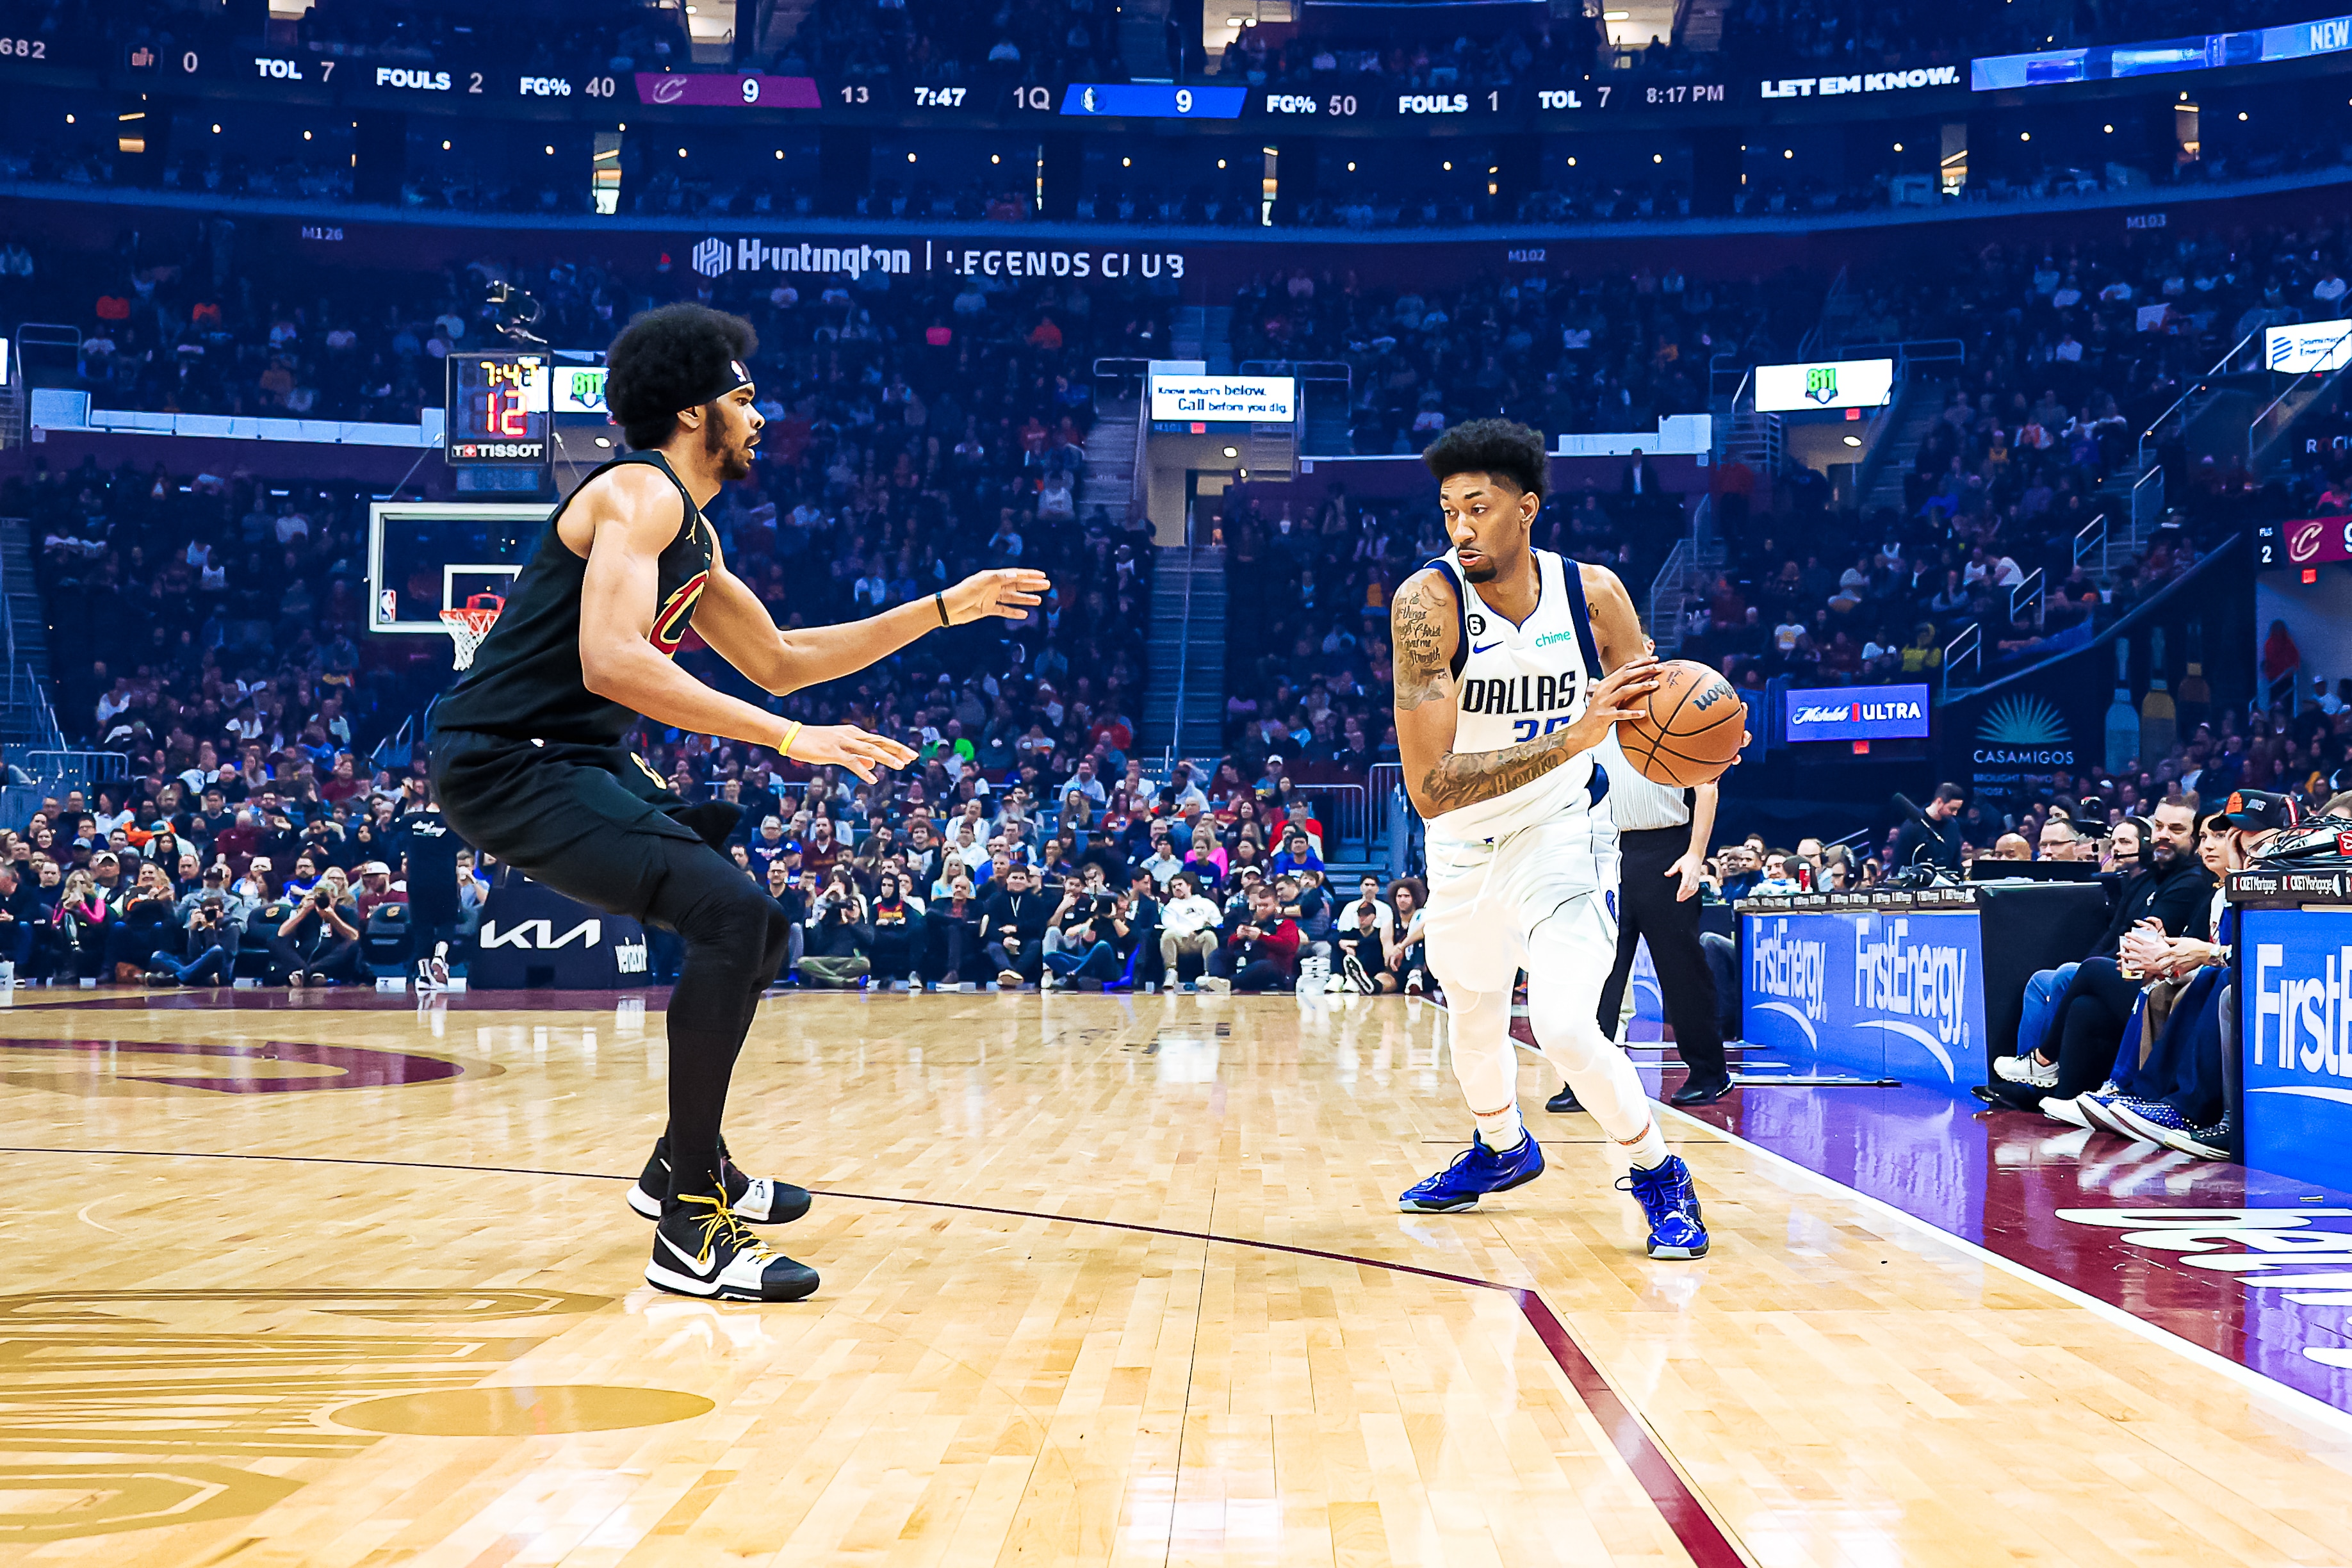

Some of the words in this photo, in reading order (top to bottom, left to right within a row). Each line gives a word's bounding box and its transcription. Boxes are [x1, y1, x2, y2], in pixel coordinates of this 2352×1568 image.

[2310, 19, 2350, 51] NEW
[255, 58, 302, 80] TOL
[320, 61, 335, 83] 7
[376, 67, 452, 91] FOULS
[469, 72, 484, 94] 2
[1761, 78, 1815, 99] LET
[1819, 74, 1862, 95] EM
[1865, 65, 1960, 93] KNOW.
[520, 76, 571, 96] FG%
[585, 76, 616, 98] 40
[742, 78, 760, 103] 9
[841, 86, 869, 104] 13
[914, 86, 967, 107] 7:47
[1013, 86, 1050, 111] 1Q
[1539, 90, 1581, 109] TOL
[1597, 86, 1612, 108] 7
[1646, 87, 1687, 104] 8:17
[1693, 84, 1725, 102] PM
[1175, 89, 1193, 113] 9
[1266, 94, 1317, 114] FG%
[1328, 94, 1358, 117] 50
[1398, 94, 1469, 114] FOULS
[1487, 90, 1499, 111] 1
[738, 238, 911, 281] Huntington
[571, 372, 607, 396] 811
[1806, 368, 1836, 391] 811
[486, 389, 528, 437] 12
[1178, 398, 1205, 411] Call
[1209, 402, 1243, 411] before
[1247, 404, 1266, 413] you
[477, 444, 543, 458] TISSOT
[2261, 545, 2273, 564] 2
[1469, 617, 1482, 634] 6
[1535, 630, 1571, 647] chime
[1461, 671, 1576, 715] DALLAS
[1863, 702, 1921, 720] ULTRA
[1973, 749, 2075, 765] CASAMIGOS
[1973, 774, 2020, 783] BROUGHT
[1752, 917, 1827, 1024] FirstEnergy
[1854, 917, 1968, 1047] FirstEnergy
